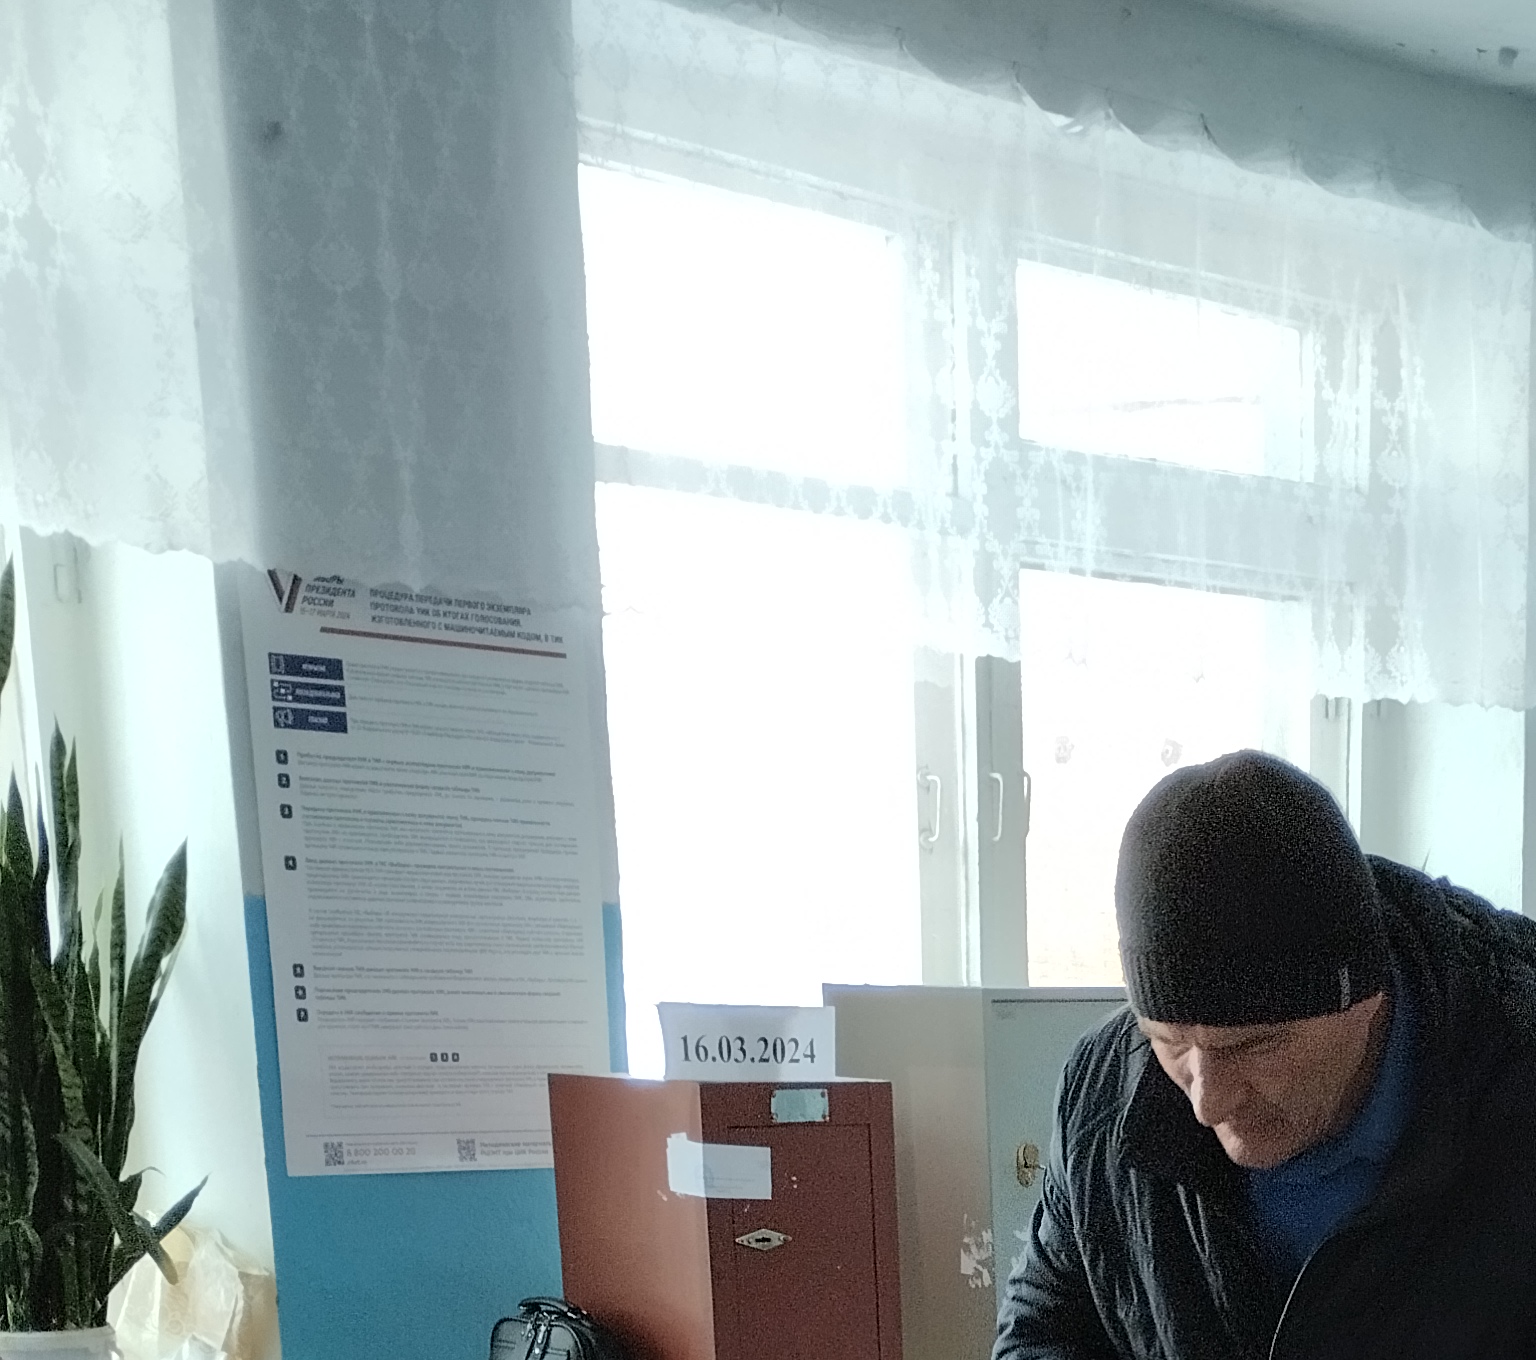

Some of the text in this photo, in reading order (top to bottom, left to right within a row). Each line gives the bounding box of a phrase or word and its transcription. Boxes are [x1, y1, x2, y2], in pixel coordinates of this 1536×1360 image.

[305, 583, 356, 598] ПРЕЗИДЕНТА
[301, 595, 334, 608] РОССИИ
[680, 1034, 817, 1064] 16.03.2024
